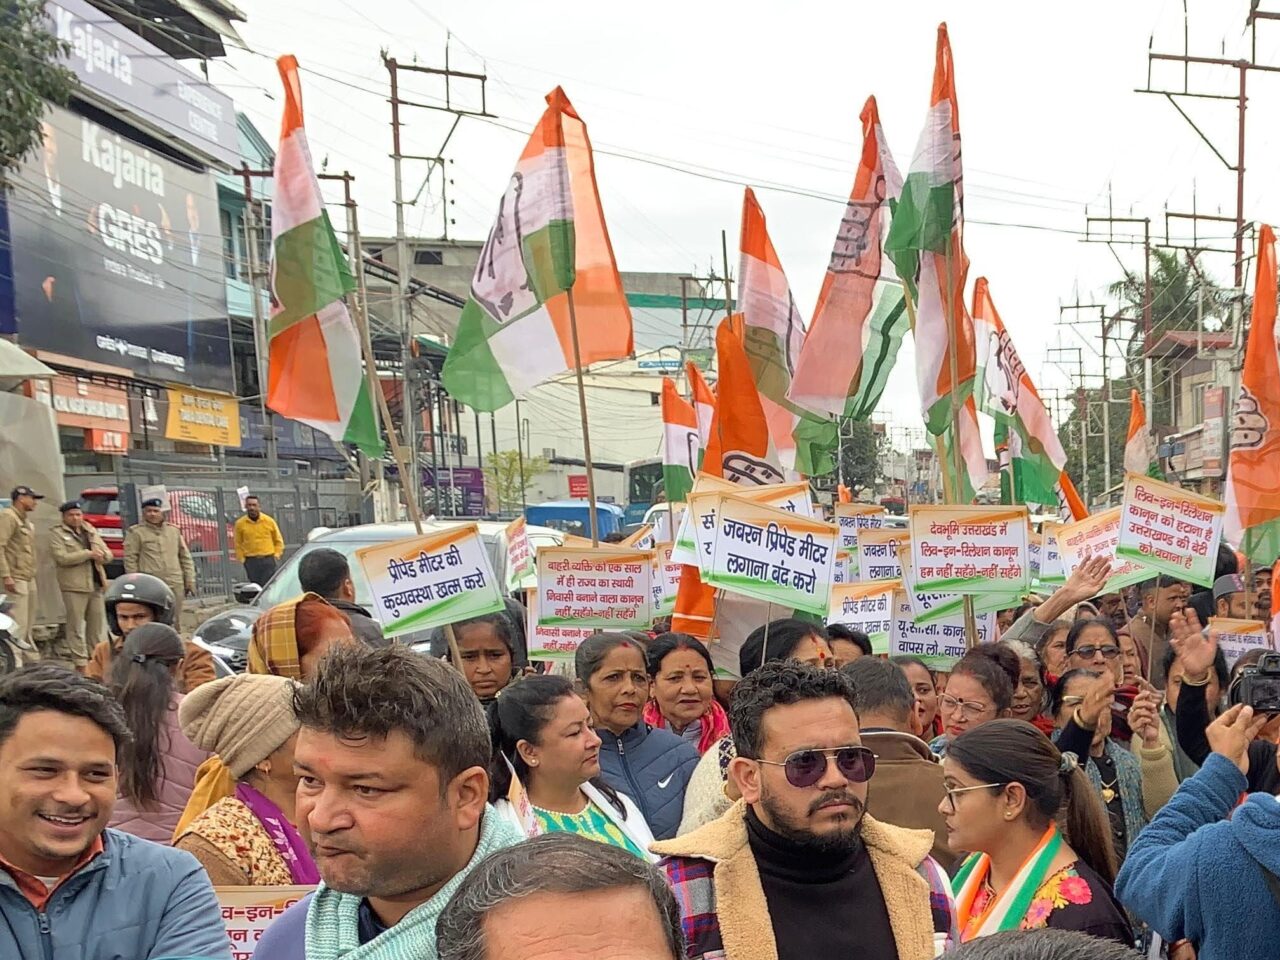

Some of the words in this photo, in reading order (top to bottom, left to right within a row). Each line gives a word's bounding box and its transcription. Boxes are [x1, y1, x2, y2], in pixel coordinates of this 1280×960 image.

[55, 6, 133, 86] Kajaria
[81, 116, 165, 197] Kajaria
[1134, 485, 1214, 524] लिव-इन-रिलेशन
[930, 521, 959, 540] देवभूमि
[962, 521, 997, 536] उत्तराखंड
[999, 521, 1008, 536] में
[1129, 503, 1159, 526] कानून
[1160, 512, 1174, 528] को
[1176, 519, 1203, 538] हटाना
[1205, 525, 1214, 542] है
[723, 518, 763, 546] जबरन
[766, 522, 796, 557] प्रिपेड
[798, 532, 829, 565] मीटर
[1128, 521, 1174, 546] उत्तराखण्ड
[1176, 533, 1191, 550] की
[1191, 539, 1208, 556] बेटी
[863, 544, 887, 557] जबरन
[921, 542, 991, 558] लिव-इन-रिलेशन
[993, 545, 1019, 562] कानून
[1139, 541, 1153, 555] को
[1155, 546, 1183, 566] बचाना
[1184, 554, 1194, 570] है
[387, 558, 417, 583] प्रीपेड
[416, 551, 445, 573] मीटर
[444, 544, 462, 566] की
[548, 559, 569, 572] बाहरी
[571, 559, 592, 572] व्यक्ति
[594, 560, 606, 572] को
[608, 562, 622, 573] एक
[624, 563, 642, 573] साल
[727, 552, 769, 581] लगाना
[771, 560, 791, 586] बंद
[792, 568, 817, 594] करो
[869, 565, 894, 578] लगाना
[920, 566, 934, 578] हम
[936, 563, 953, 578] नहीं
[1000, 564, 1022, 578] सहेंगे
[556, 576, 566, 587] में
[566, 576, 575, 588] ही
[577, 578, 596, 588] राज्य
[598, 578, 610, 588] का
[611, 576, 634, 588] स्थायी
[381, 585, 434, 618] कुव्यवस्था
[433, 578, 463, 599] खत्म
[462, 567, 486, 591] करो
[546, 589, 574, 602] निवासी
[575, 590, 597, 602] बनाने
[599, 593, 618, 604] वाला
[620, 595, 644, 608] कानून
[554, 606, 571, 618] नहीं
[615, 607, 637, 619] सहेंगे
[943, 625, 966, 644] कानू
[899, 641, 923, 654] वापस
